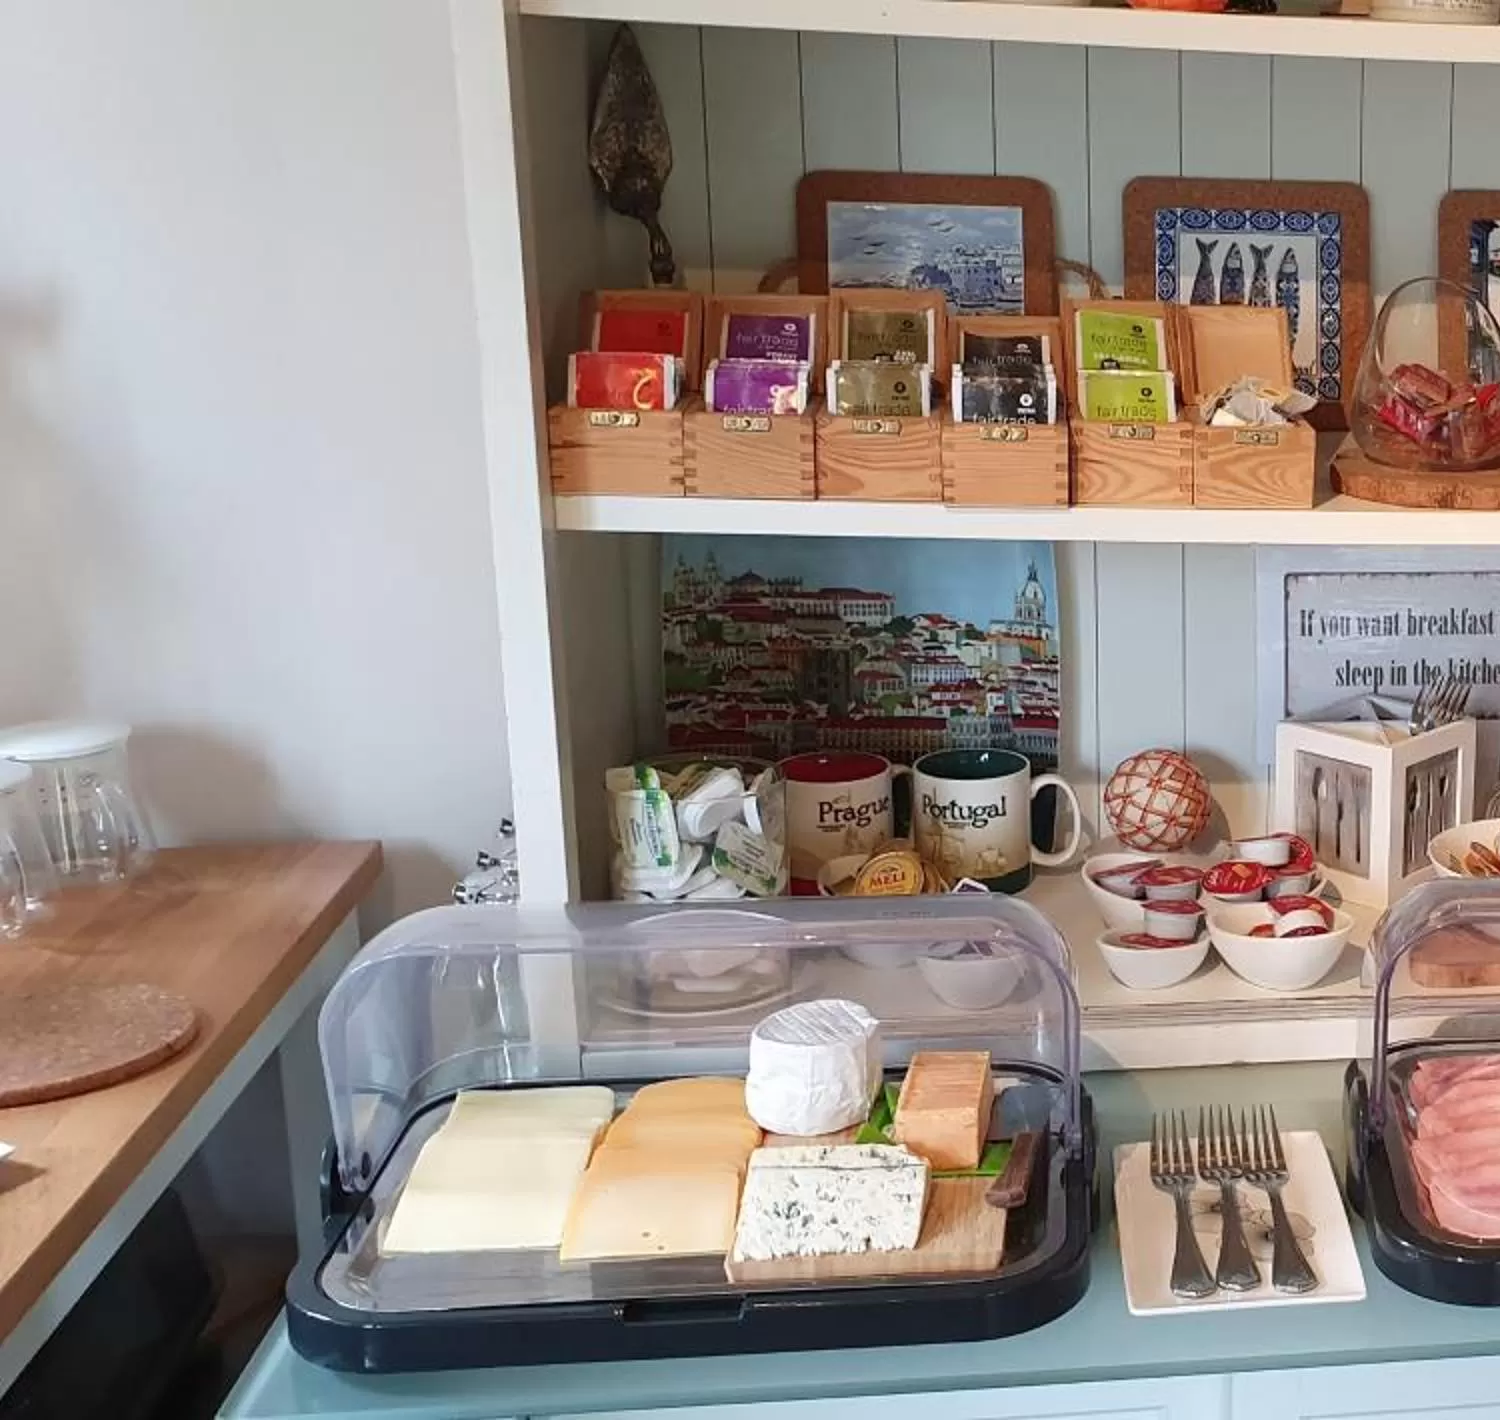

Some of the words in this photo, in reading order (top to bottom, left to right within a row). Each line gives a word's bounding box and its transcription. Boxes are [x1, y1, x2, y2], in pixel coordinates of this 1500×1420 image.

[1300, 609, 1314, 637] If
[1319, 615, 1351, 644] you
[1357, 611, 1400, 637] want
[1407, 607, 1495, 637] breakfast
[1335, 659, 1384, 694] sleep
[1390, 660, 1407, 686] in
[1413, 659, 1443, 686] the
[922, 794, 1007, 828] Portugal
